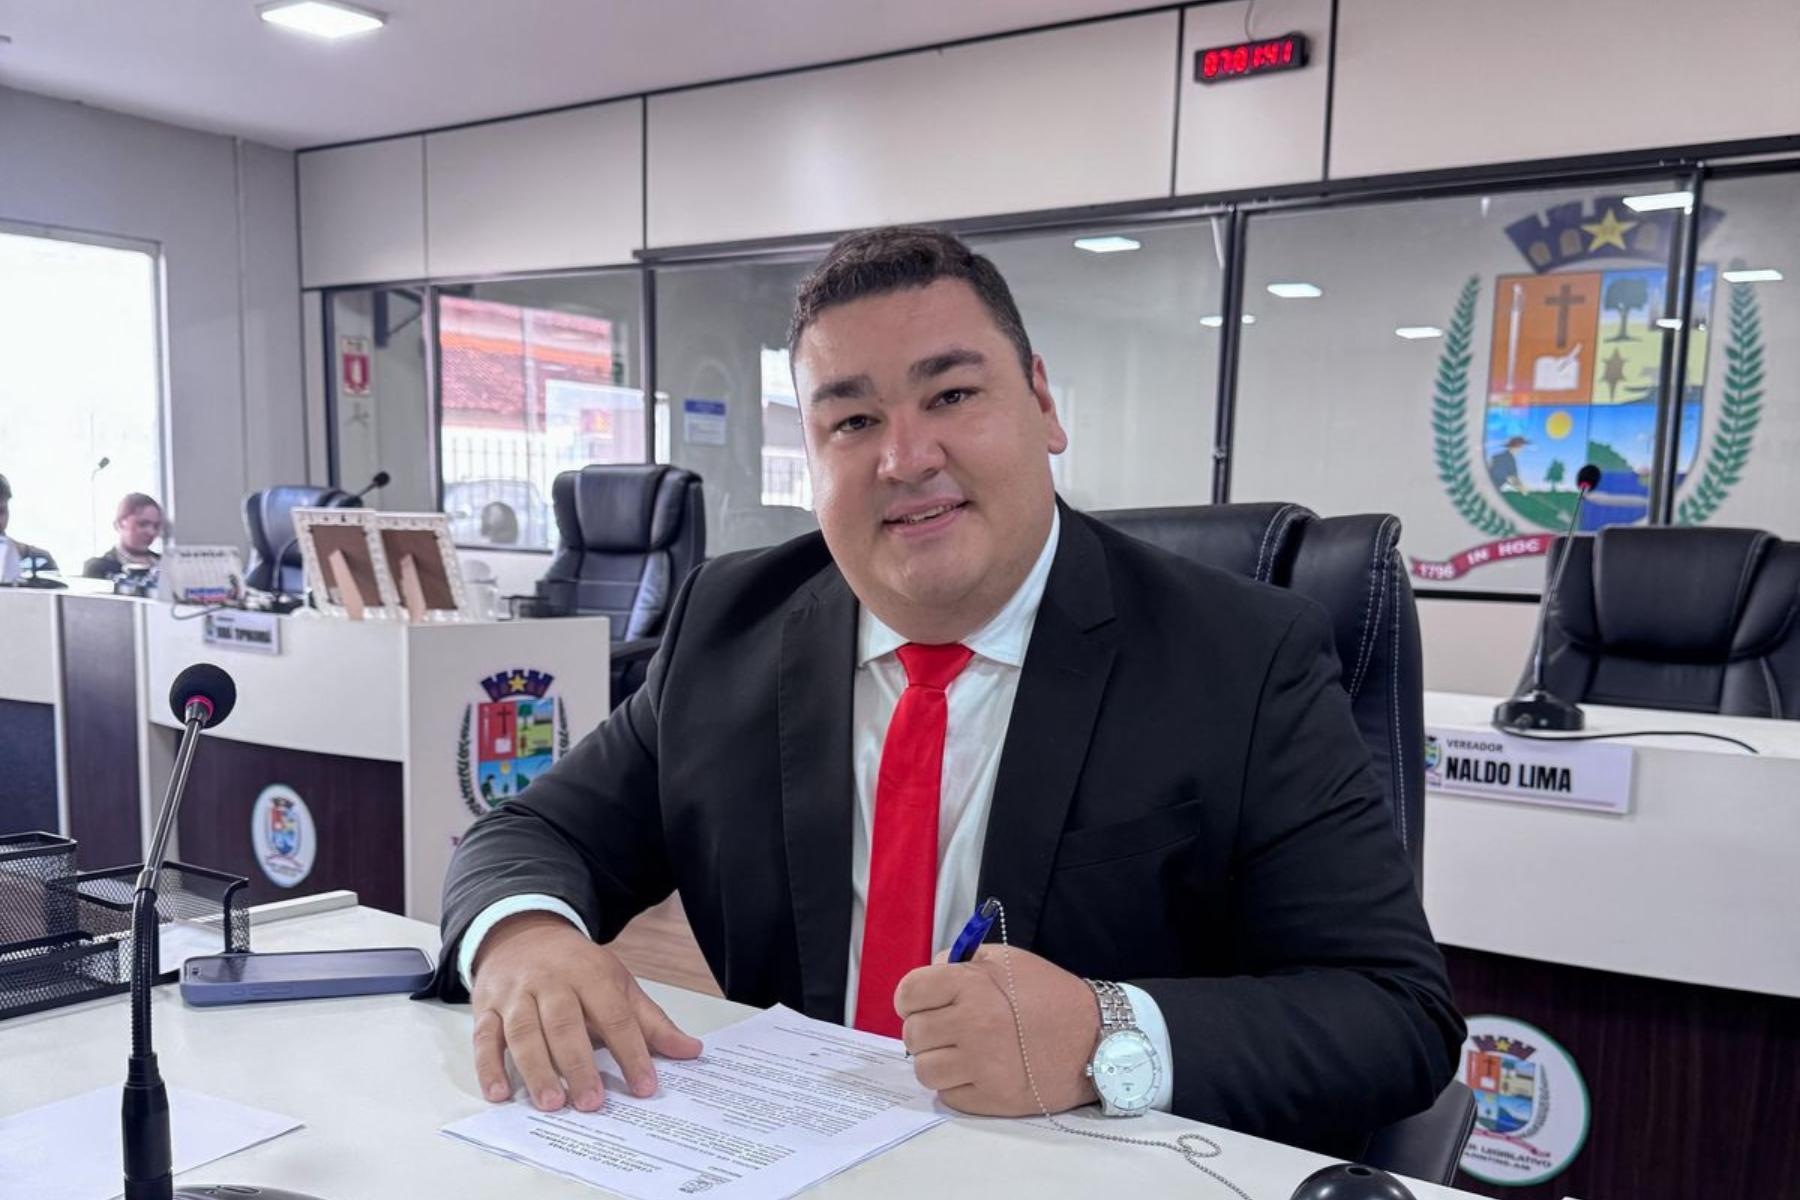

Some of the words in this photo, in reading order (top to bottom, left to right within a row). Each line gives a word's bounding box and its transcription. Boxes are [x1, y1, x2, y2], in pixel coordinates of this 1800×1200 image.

[1418, 563, 1455, 578] 1796
[1467, 547, 1489, 565] IN
[1498, 538, 1540, 557] HOC
[1446, 739, 1504, 753] VEREADOR
[1445, 756, 1511, 786] NALDO
[1517, 763, 1571, 793] LIMA
